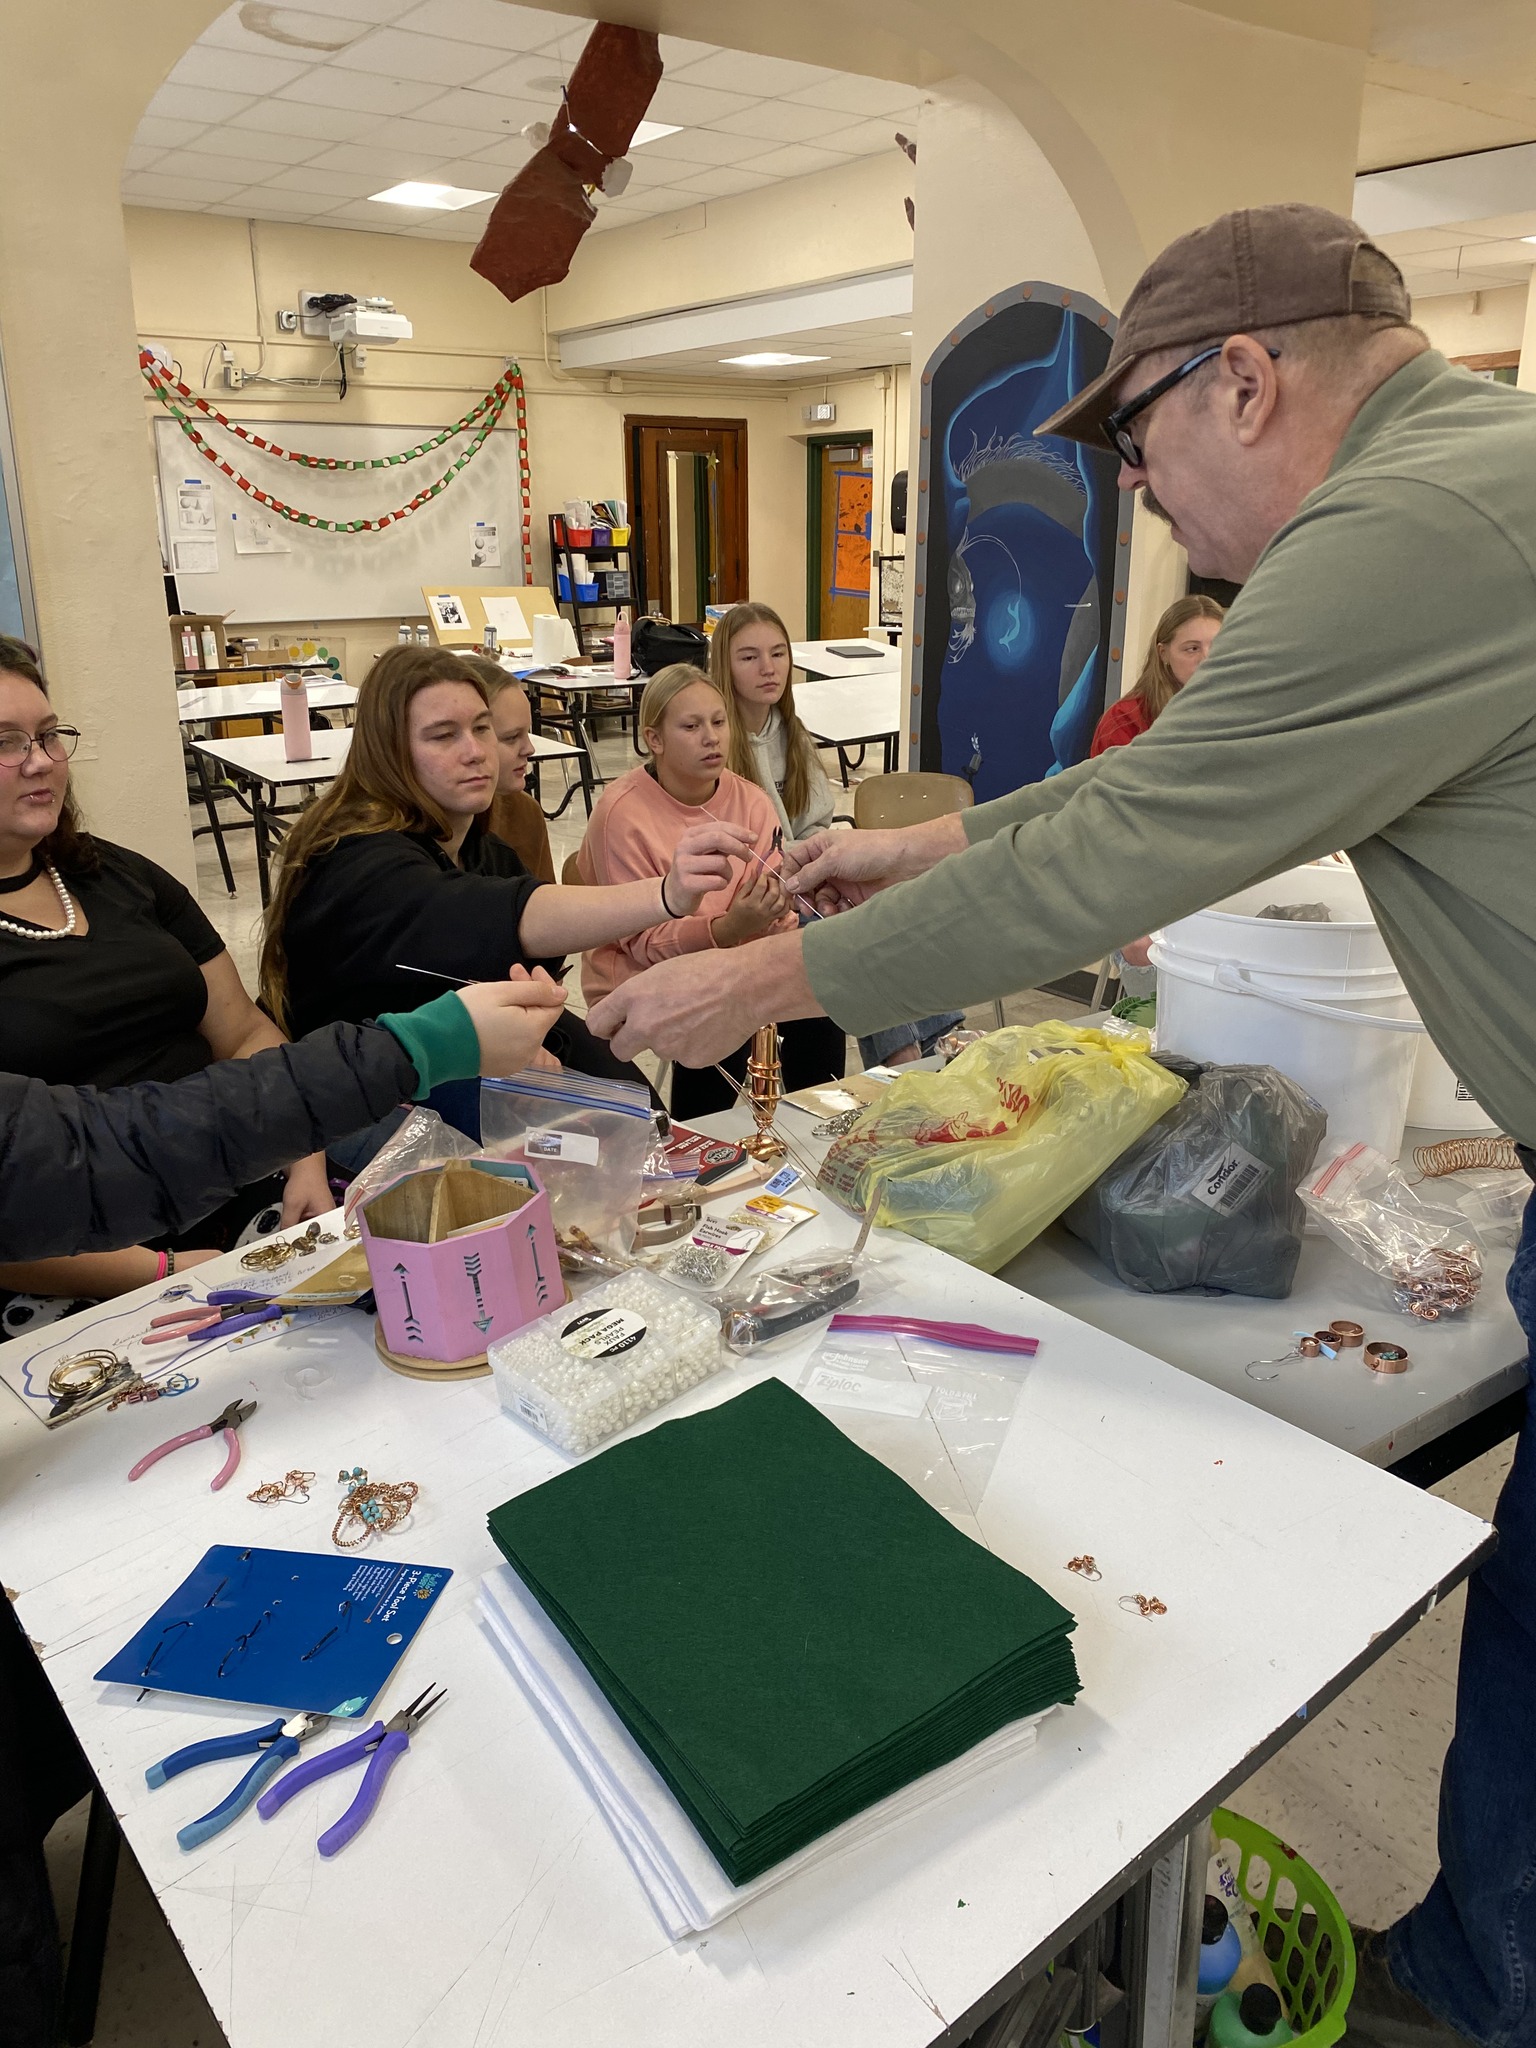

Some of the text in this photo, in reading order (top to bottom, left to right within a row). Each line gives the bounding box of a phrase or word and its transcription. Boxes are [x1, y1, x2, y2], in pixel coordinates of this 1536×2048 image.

[1207, 1160, 1238, 1195] Condor
[601, 1318, 625, 1332] MEGA
[579, 1331, 602, 1345] PACK
[594, 1327, 625, 1345] PEARLS
[604, 1332, 625, 1345] FAUX
[619, 1336, 636, 1348] 4110
[817, 1374, 862, 1393] Ziploc
[399, 1570, 421, 1595] 3-Piece
[390, 1595, 406, 1610] Tool
[381, 1609, 397, 1622] Set
